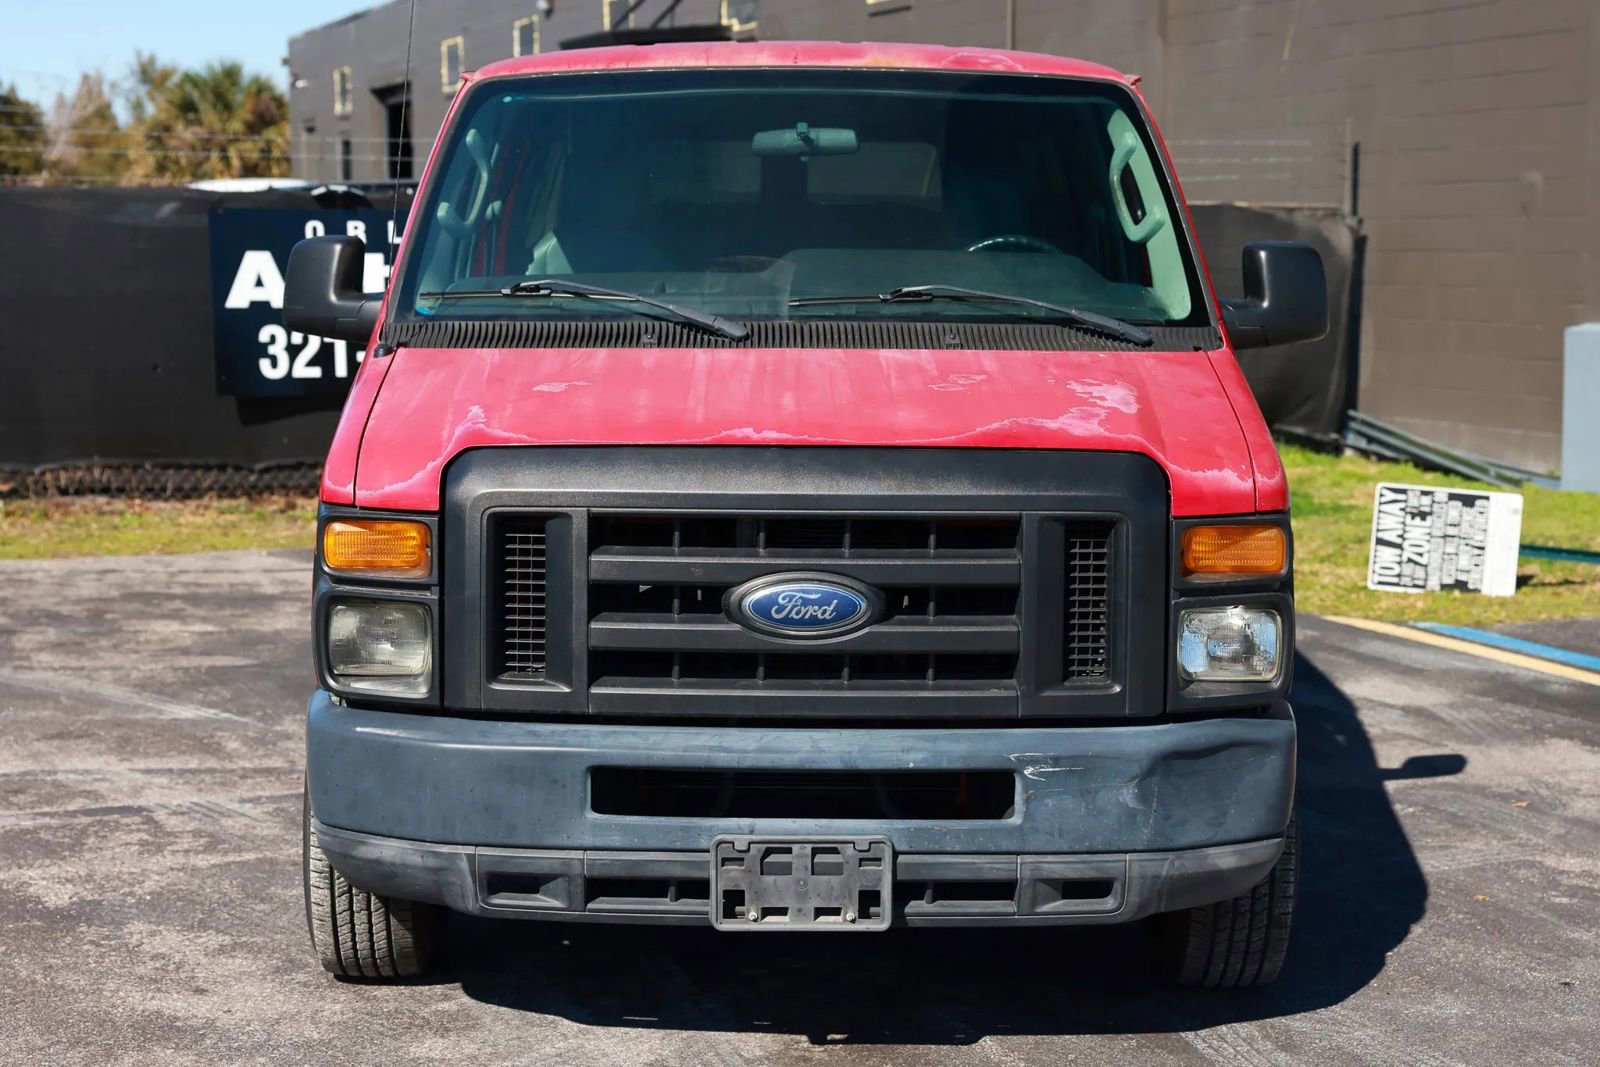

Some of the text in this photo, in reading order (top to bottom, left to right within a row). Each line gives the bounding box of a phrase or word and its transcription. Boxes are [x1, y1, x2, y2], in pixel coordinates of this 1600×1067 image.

[1373, 488, 1406, 583] TOW AWAY
[1404, 514, 1432, 564] ZONE
[771, 591, 838, 619] Ford
